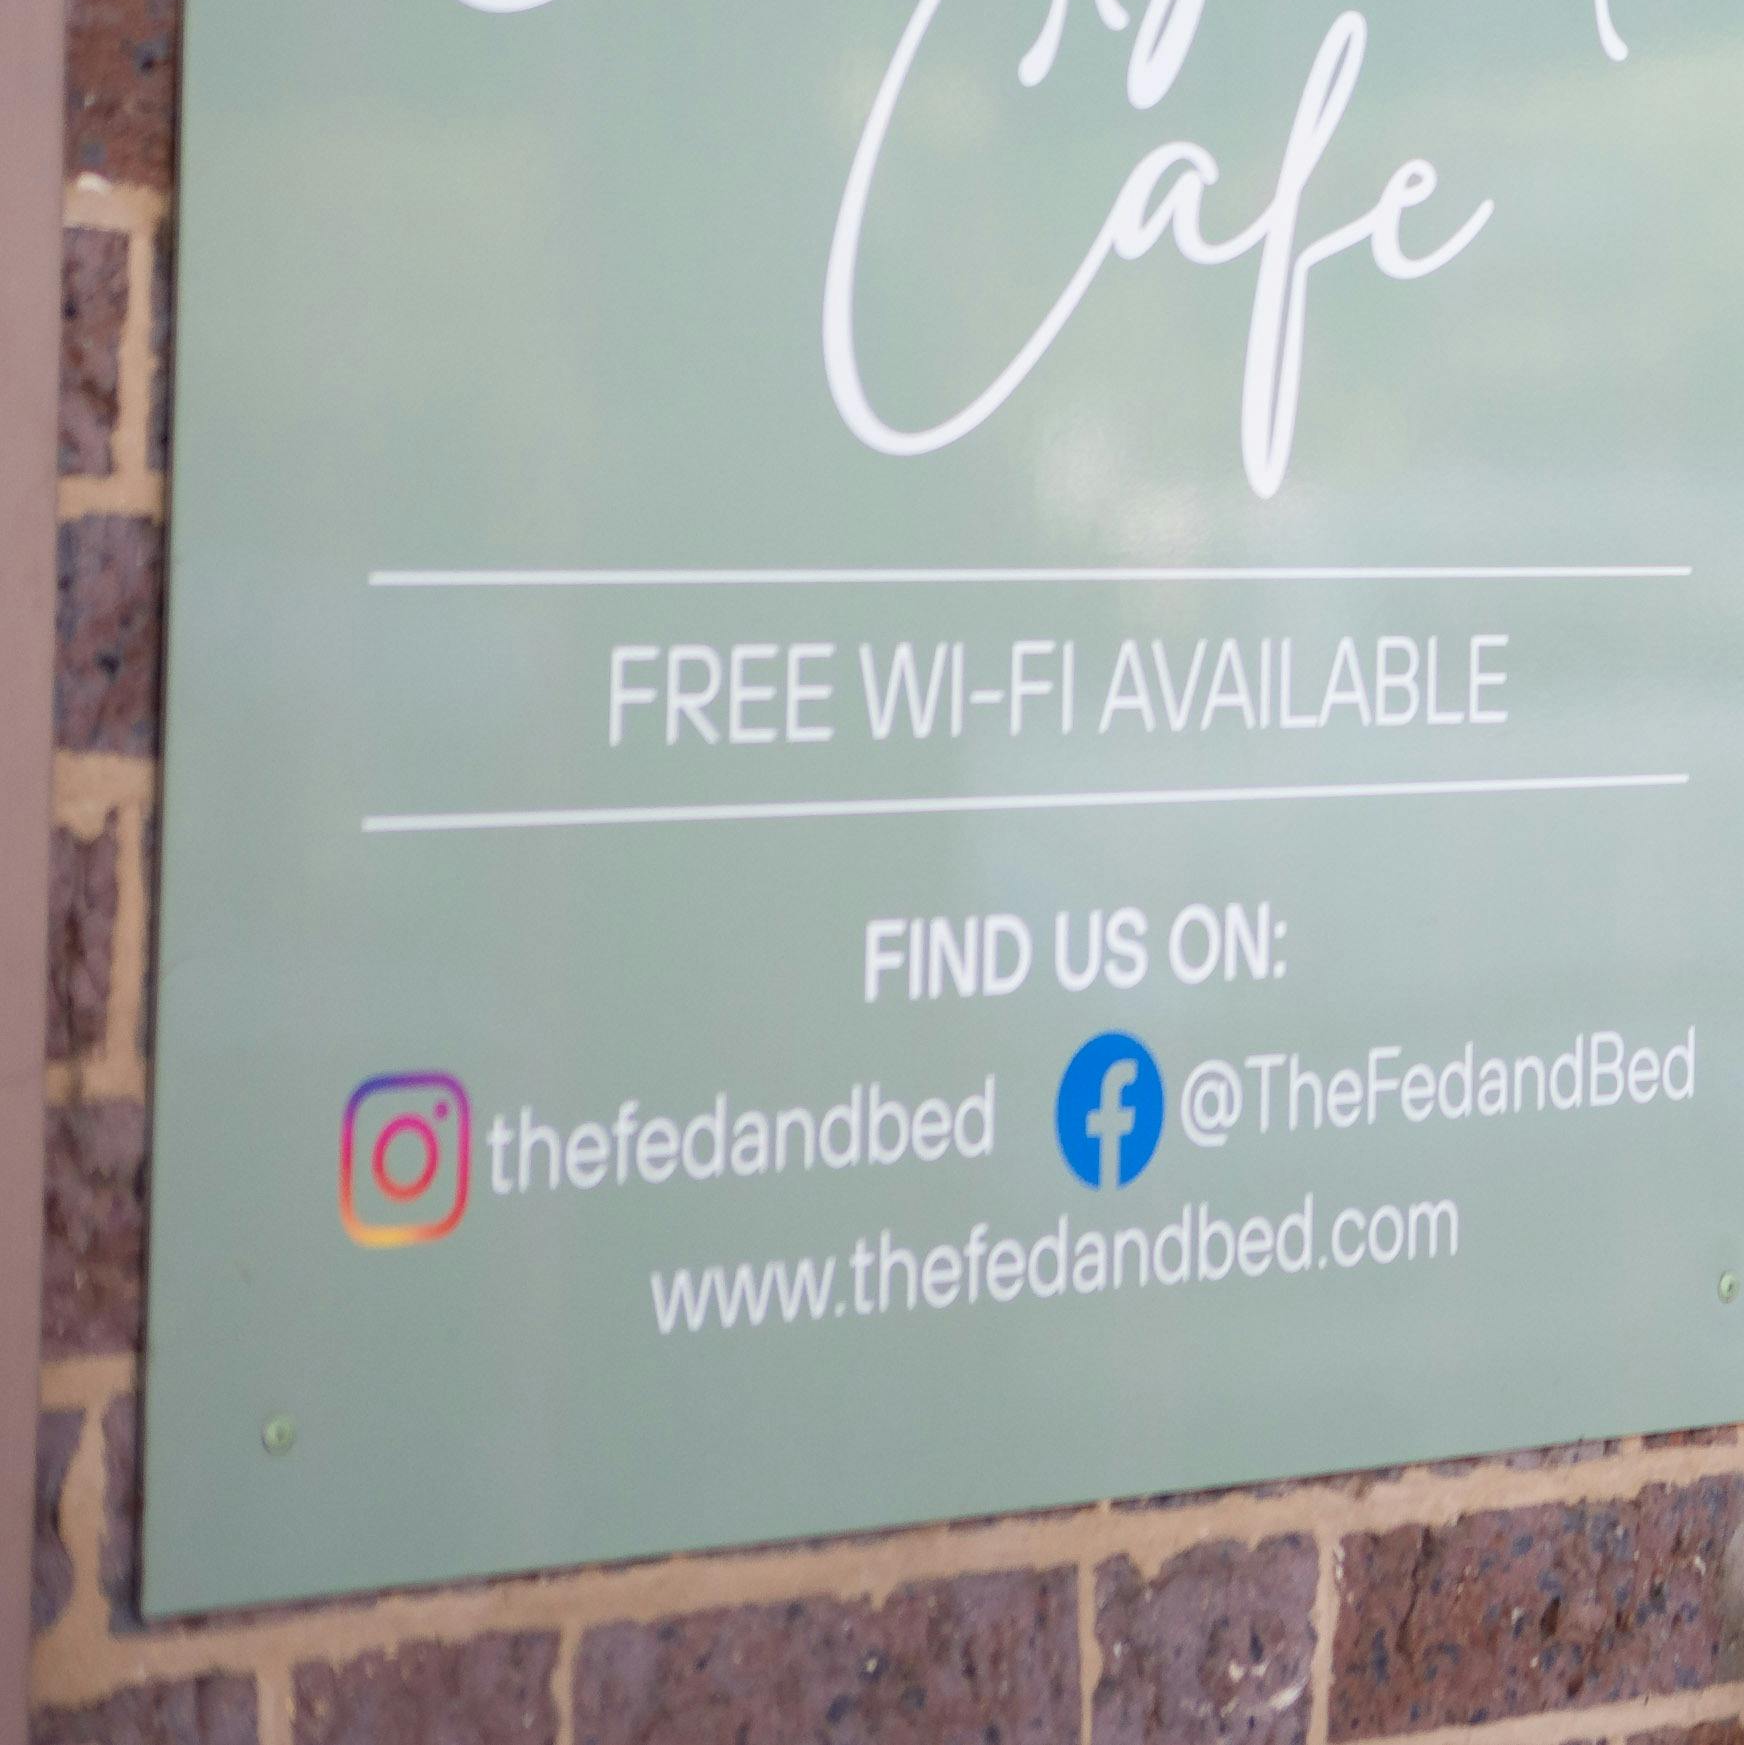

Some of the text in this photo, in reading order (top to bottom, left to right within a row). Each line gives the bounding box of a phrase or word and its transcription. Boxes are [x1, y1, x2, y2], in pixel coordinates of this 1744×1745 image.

[608, 632, 1511, 748] FREE WI-FI AVAILABLE
[865, 902, 1288, 1004] FIND US ON:
[486, 1076, 996, 1195] thefedandbed
[1180, 1027, 1697, 1148] @TheFedandBed
[651, 1193, 1458, 1336] www.thefedandbed.com
